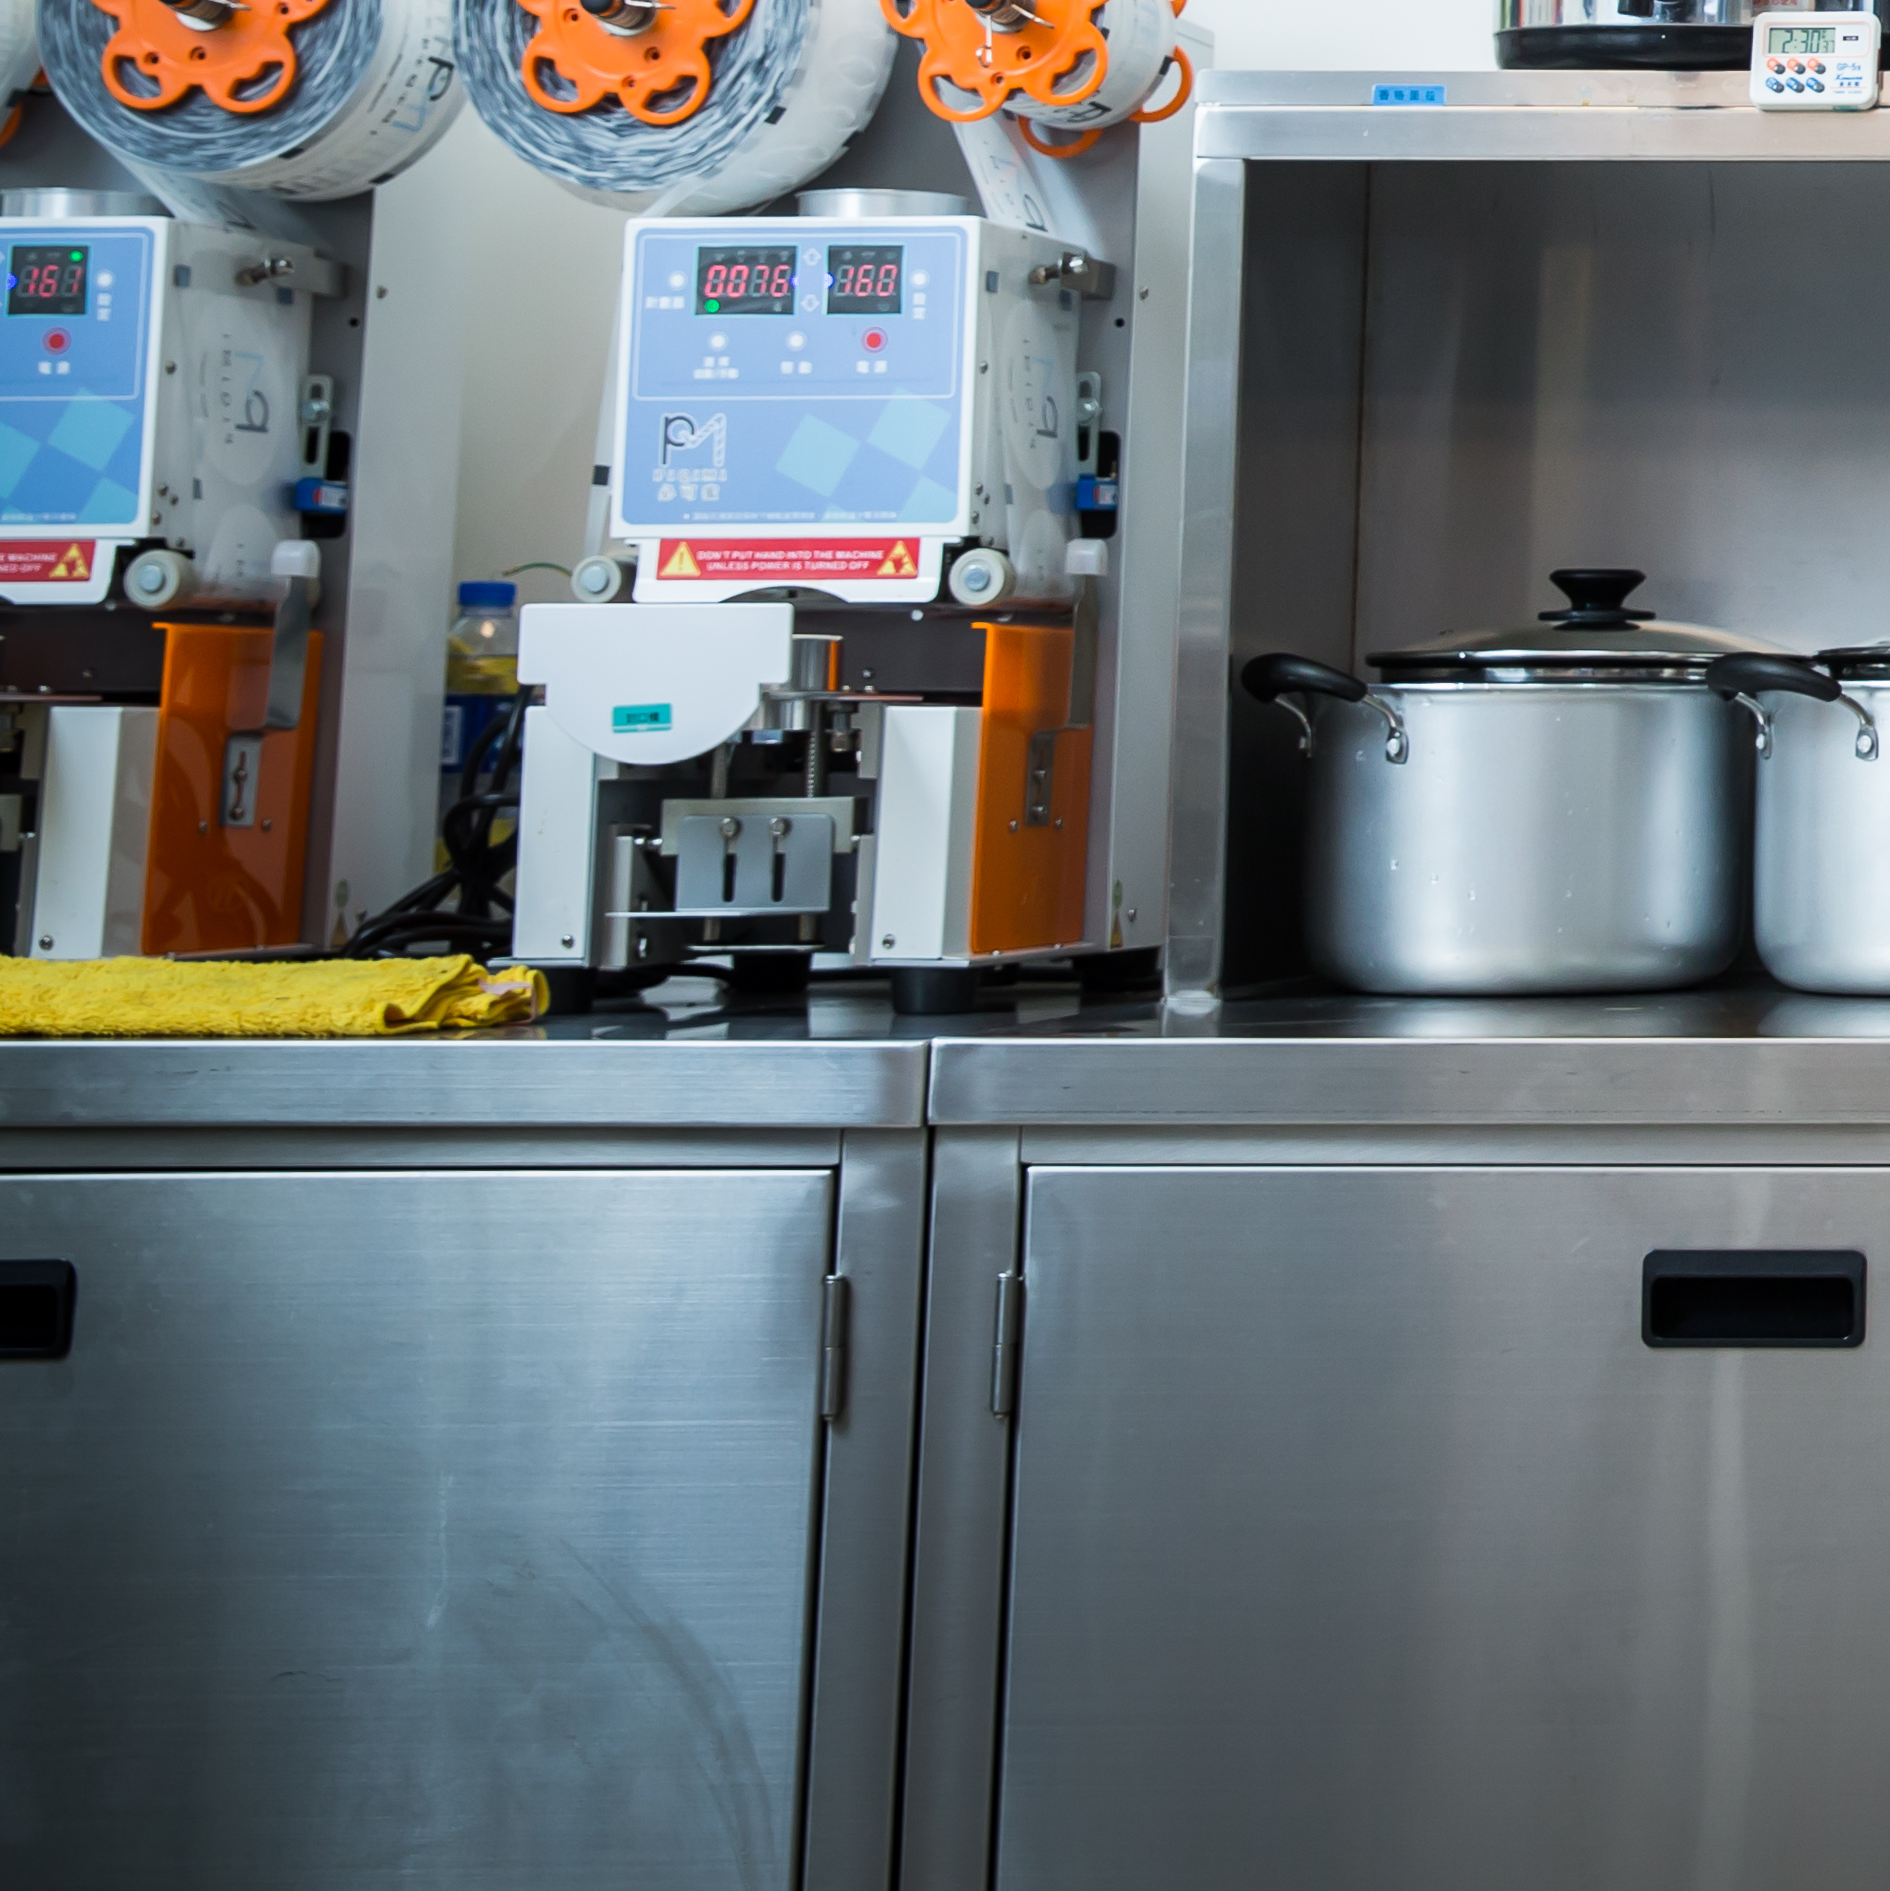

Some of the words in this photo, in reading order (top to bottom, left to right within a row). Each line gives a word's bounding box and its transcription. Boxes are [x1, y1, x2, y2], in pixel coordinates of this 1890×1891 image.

[704, 264, 791, 298] 0076
[844, 263, 899, 297] 160
[751, 560, 790, 571] POWER
[805, 560, 847, 571] TURNED
[848, 560, 869, 571] OFF
[835, 550, 884, 560] MACHINE
